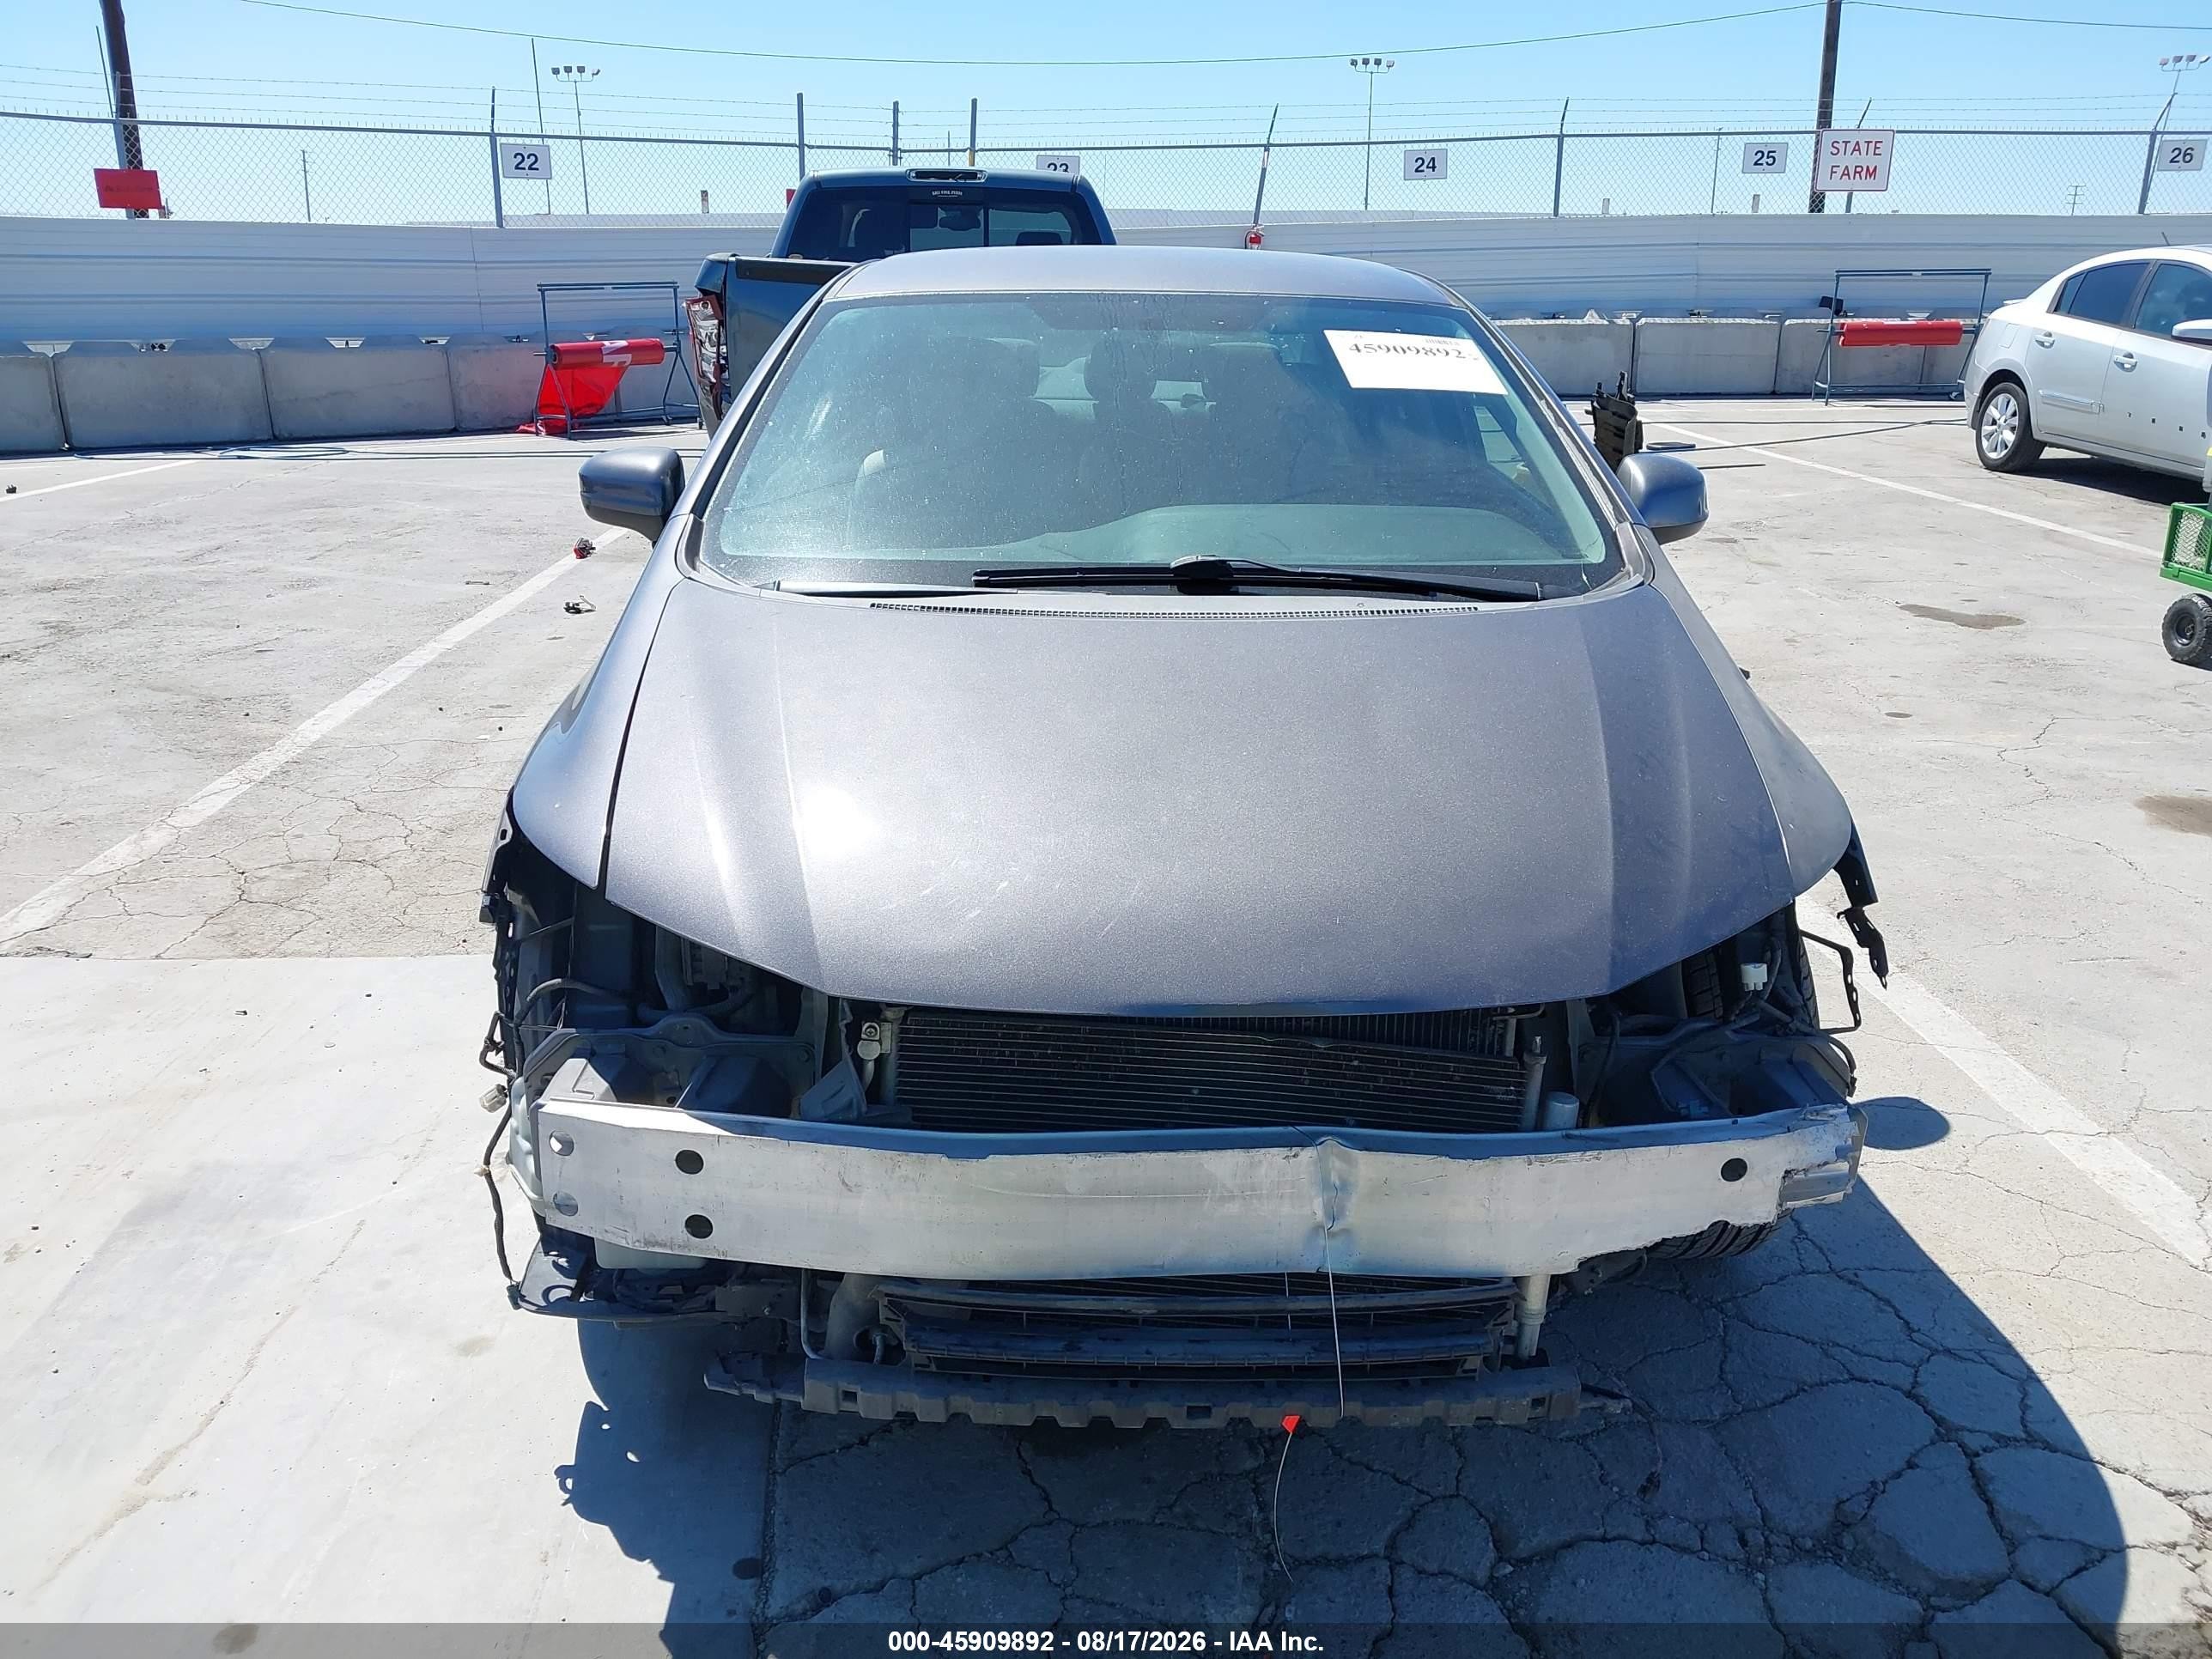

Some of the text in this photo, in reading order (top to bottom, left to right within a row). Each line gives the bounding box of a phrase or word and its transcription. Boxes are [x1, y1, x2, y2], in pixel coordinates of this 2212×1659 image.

[1830, 140, 1883, 156] STATE
[2169, 147, 2194, 163] 26
[514, 153, 539, 170] 22
[1414, 157, 1437, 173] 24
[1753, 150, 1777, 167] 25
[1829, 165, 1878, 180] FARM
